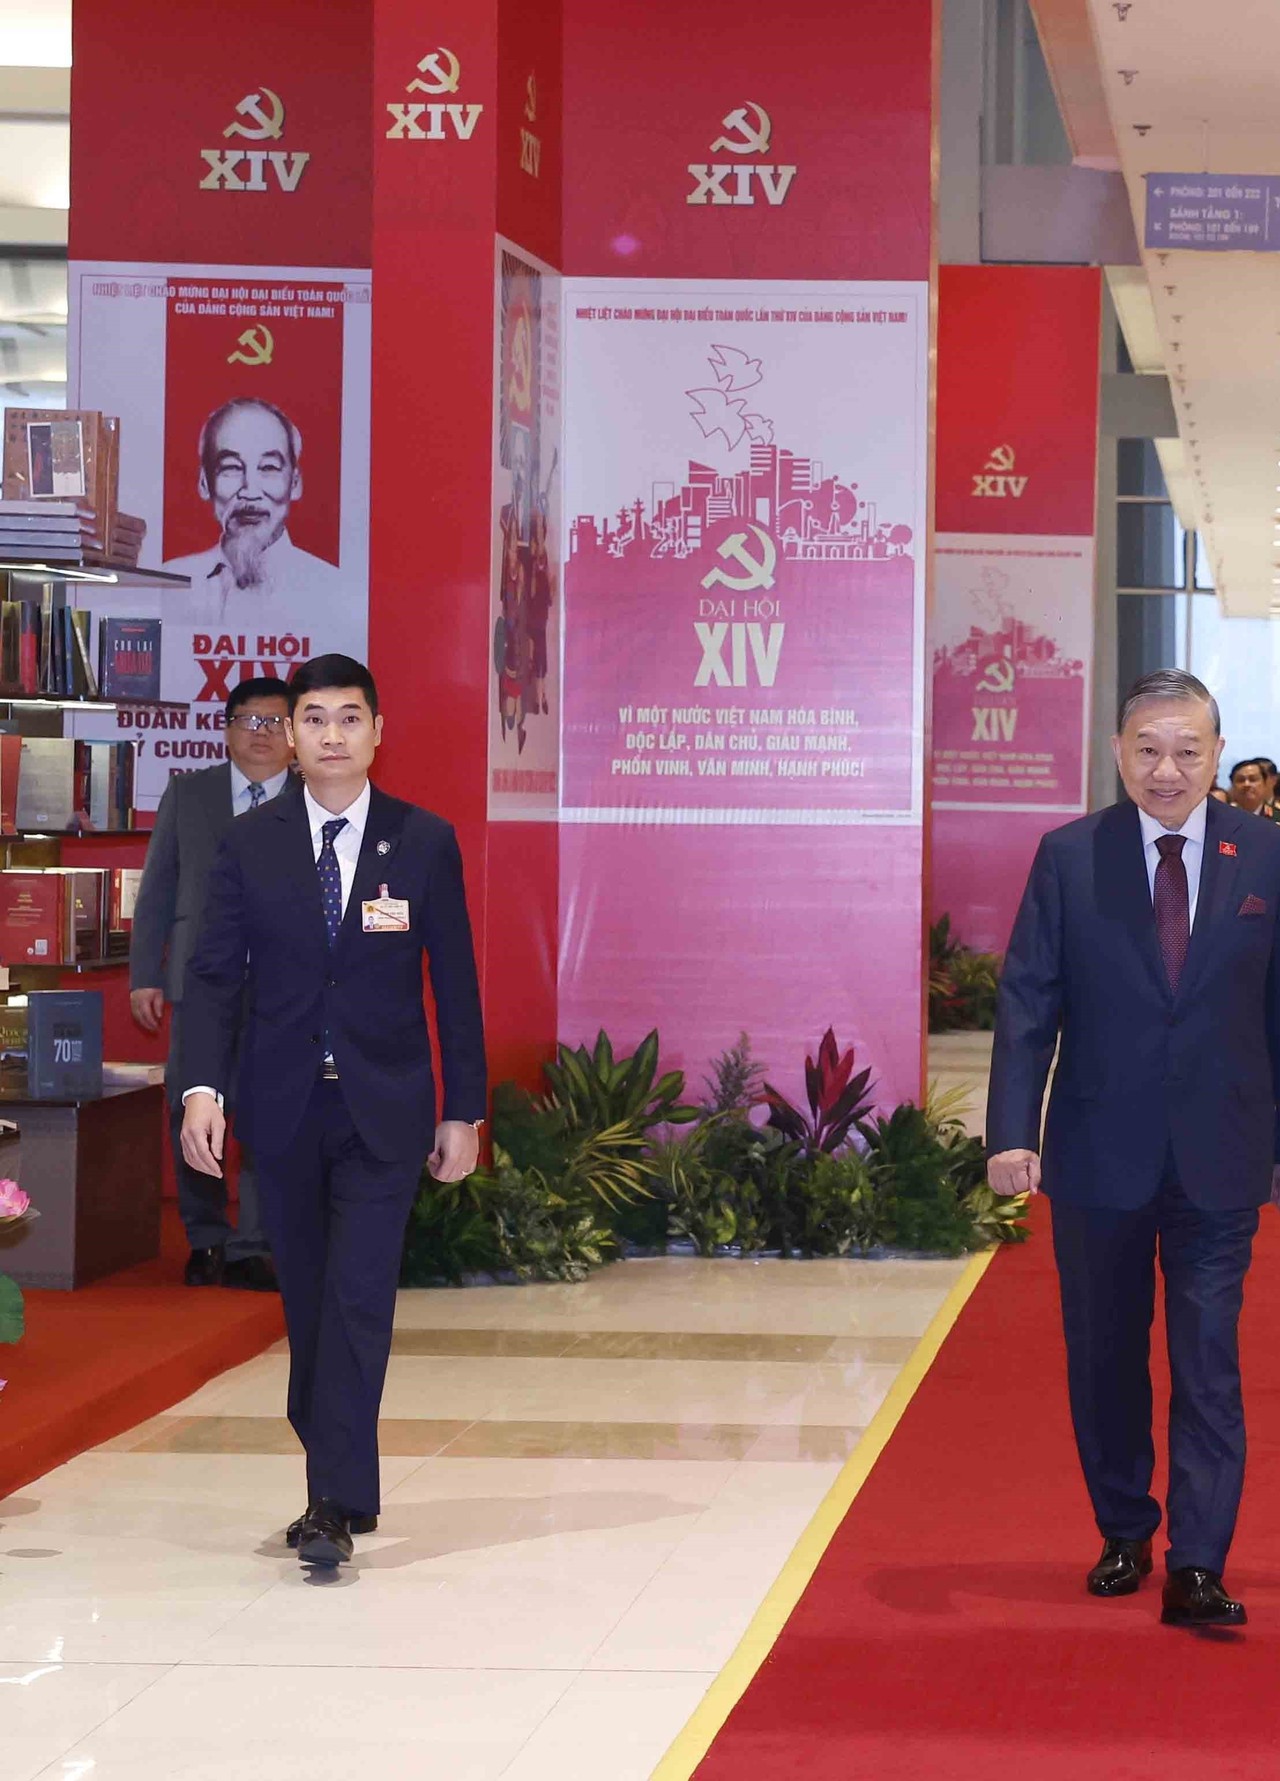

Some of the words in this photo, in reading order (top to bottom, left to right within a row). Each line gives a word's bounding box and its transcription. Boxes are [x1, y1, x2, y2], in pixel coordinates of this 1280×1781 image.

[386, 104, 483, 140] XIV
[200, 149, 310, 192] XIV
[687, 164, 797, 205] XIV
[971, 475, 1029, 498] XIV
[193, 634, 246, 659] ĐẠI
[257, 633, 310, 661] HỘI
[693, 622, 785, 687] XIV
[637, 705, 668, 728] MỘT
[715, 705, 746, 728] VIỆT
[750, 708, 783, 725] NAM
[971, 707, 1017, 742] XIV
[54, 1039, 71, 1062] 70
